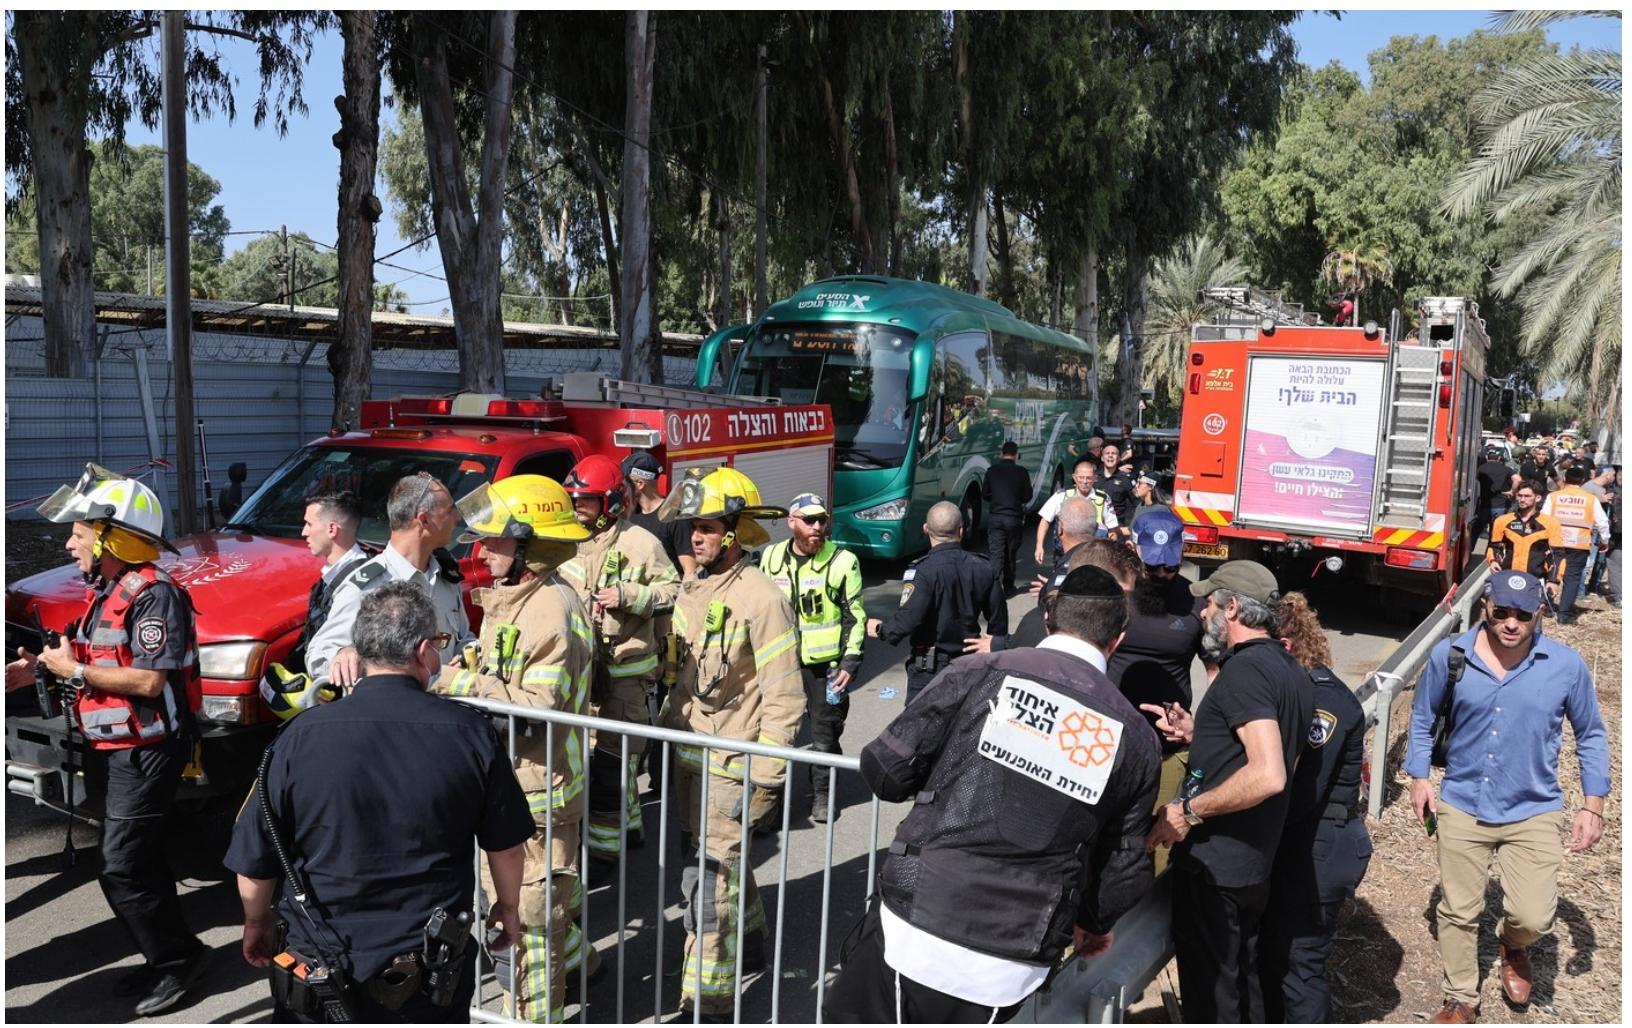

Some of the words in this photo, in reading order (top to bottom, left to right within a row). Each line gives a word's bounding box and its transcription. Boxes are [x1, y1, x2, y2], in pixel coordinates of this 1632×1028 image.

[1288, 364, 1313, 374] הבאה
[1316, 366, 1351, 375] הכתובת
[1289, 374, 1314, 384] להיות
[1317, 375, 1345, 386] עלולה
[1278, 386, 1315, 406] שלך!
[1320, 391, 1357, 405] הבית
[684, 414, 711, 443] 102
[728, 411, 777, 438] והצלה
[784, 411, 825, 433] כבאות
[1272, 464, 1292, 476] עשן
[1294, 465, 1315, 477] גלאי
[1274, 481, 1304, 495] חיים!
[1006, 686, 1060, 719] איחוד
[1011, 701, 1055, 735] הצל
[980, 740, 1053, 781] האופנועים
[1056, 775, 1098, 799] יחידת
